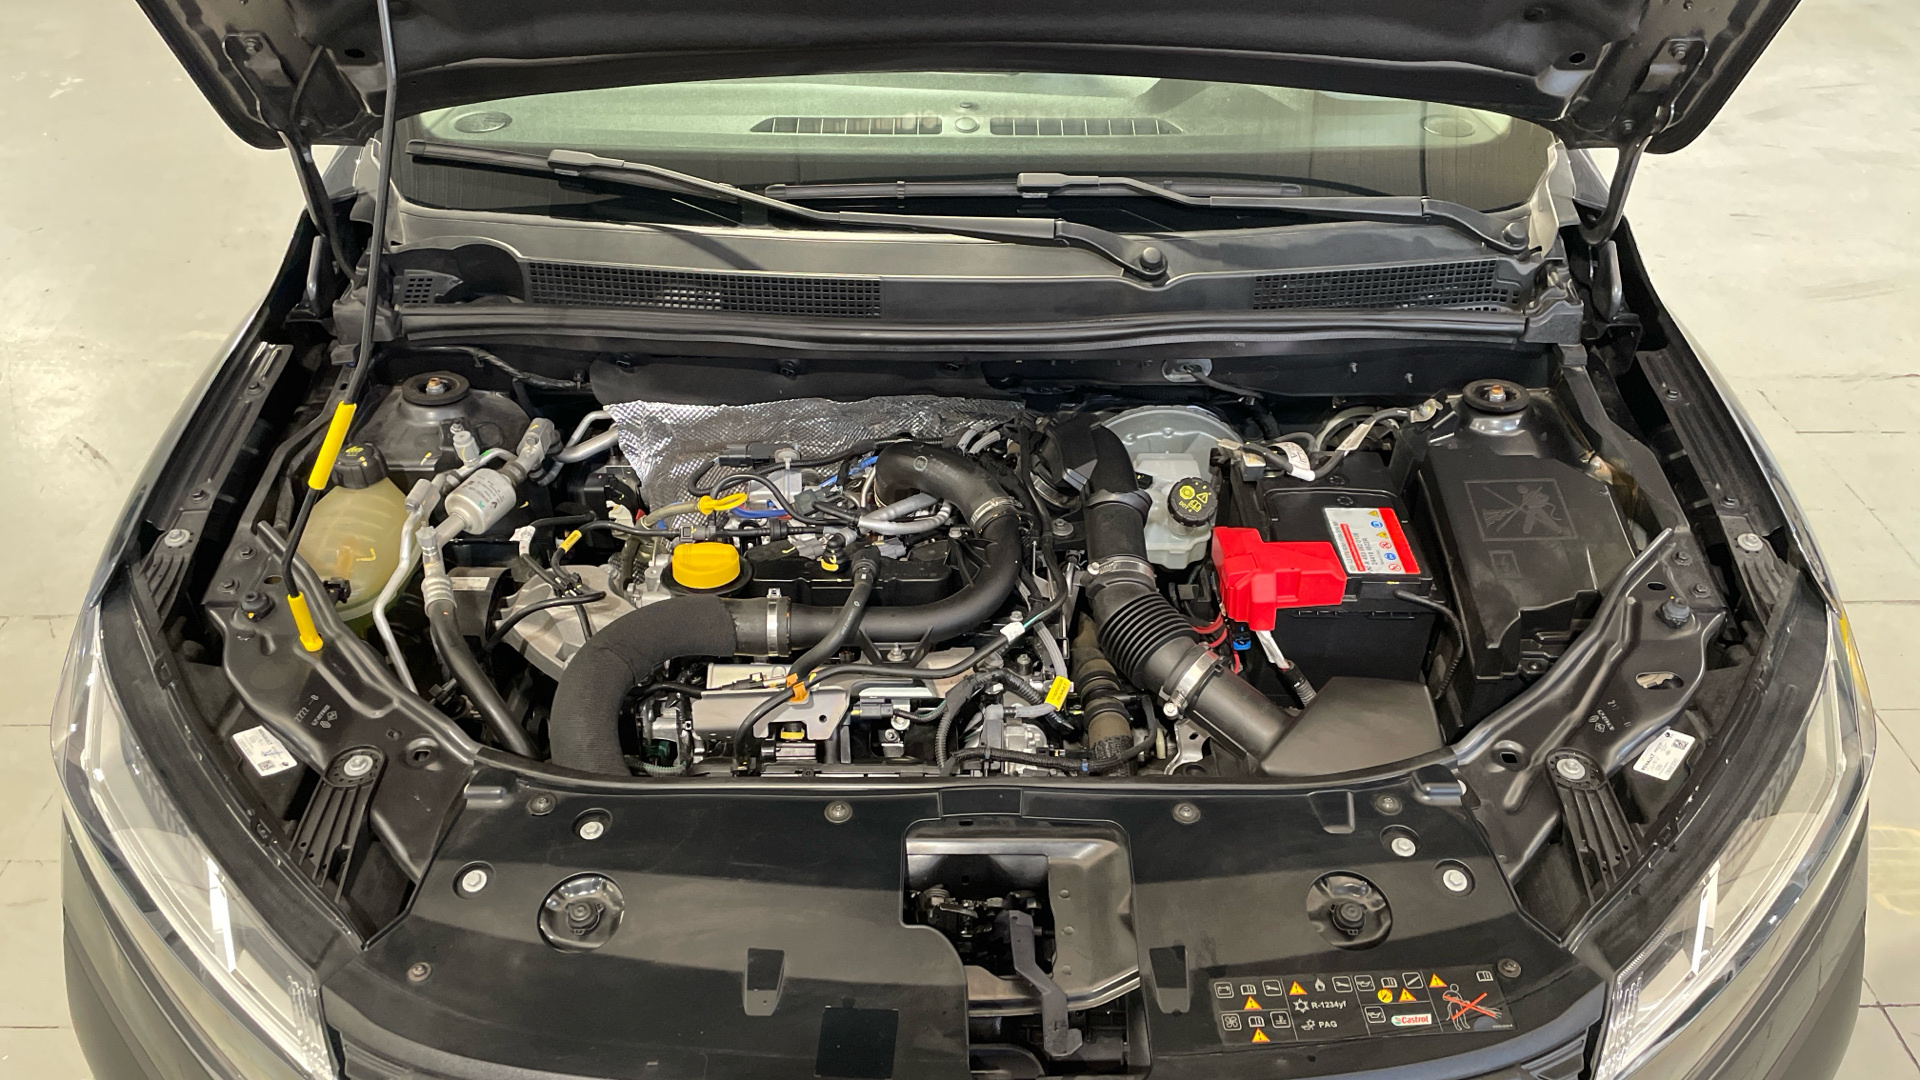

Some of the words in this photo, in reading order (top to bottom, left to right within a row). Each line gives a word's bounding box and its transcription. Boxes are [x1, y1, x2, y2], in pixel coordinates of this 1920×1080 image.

[1641, 753, 1654, 770] RENAULT
[1311, 1001, 1347, 1010] R-1234yf
[1318, 1020, 1338, 1029] PAG
[1401, 1015, 1430, 1025] Castrol
